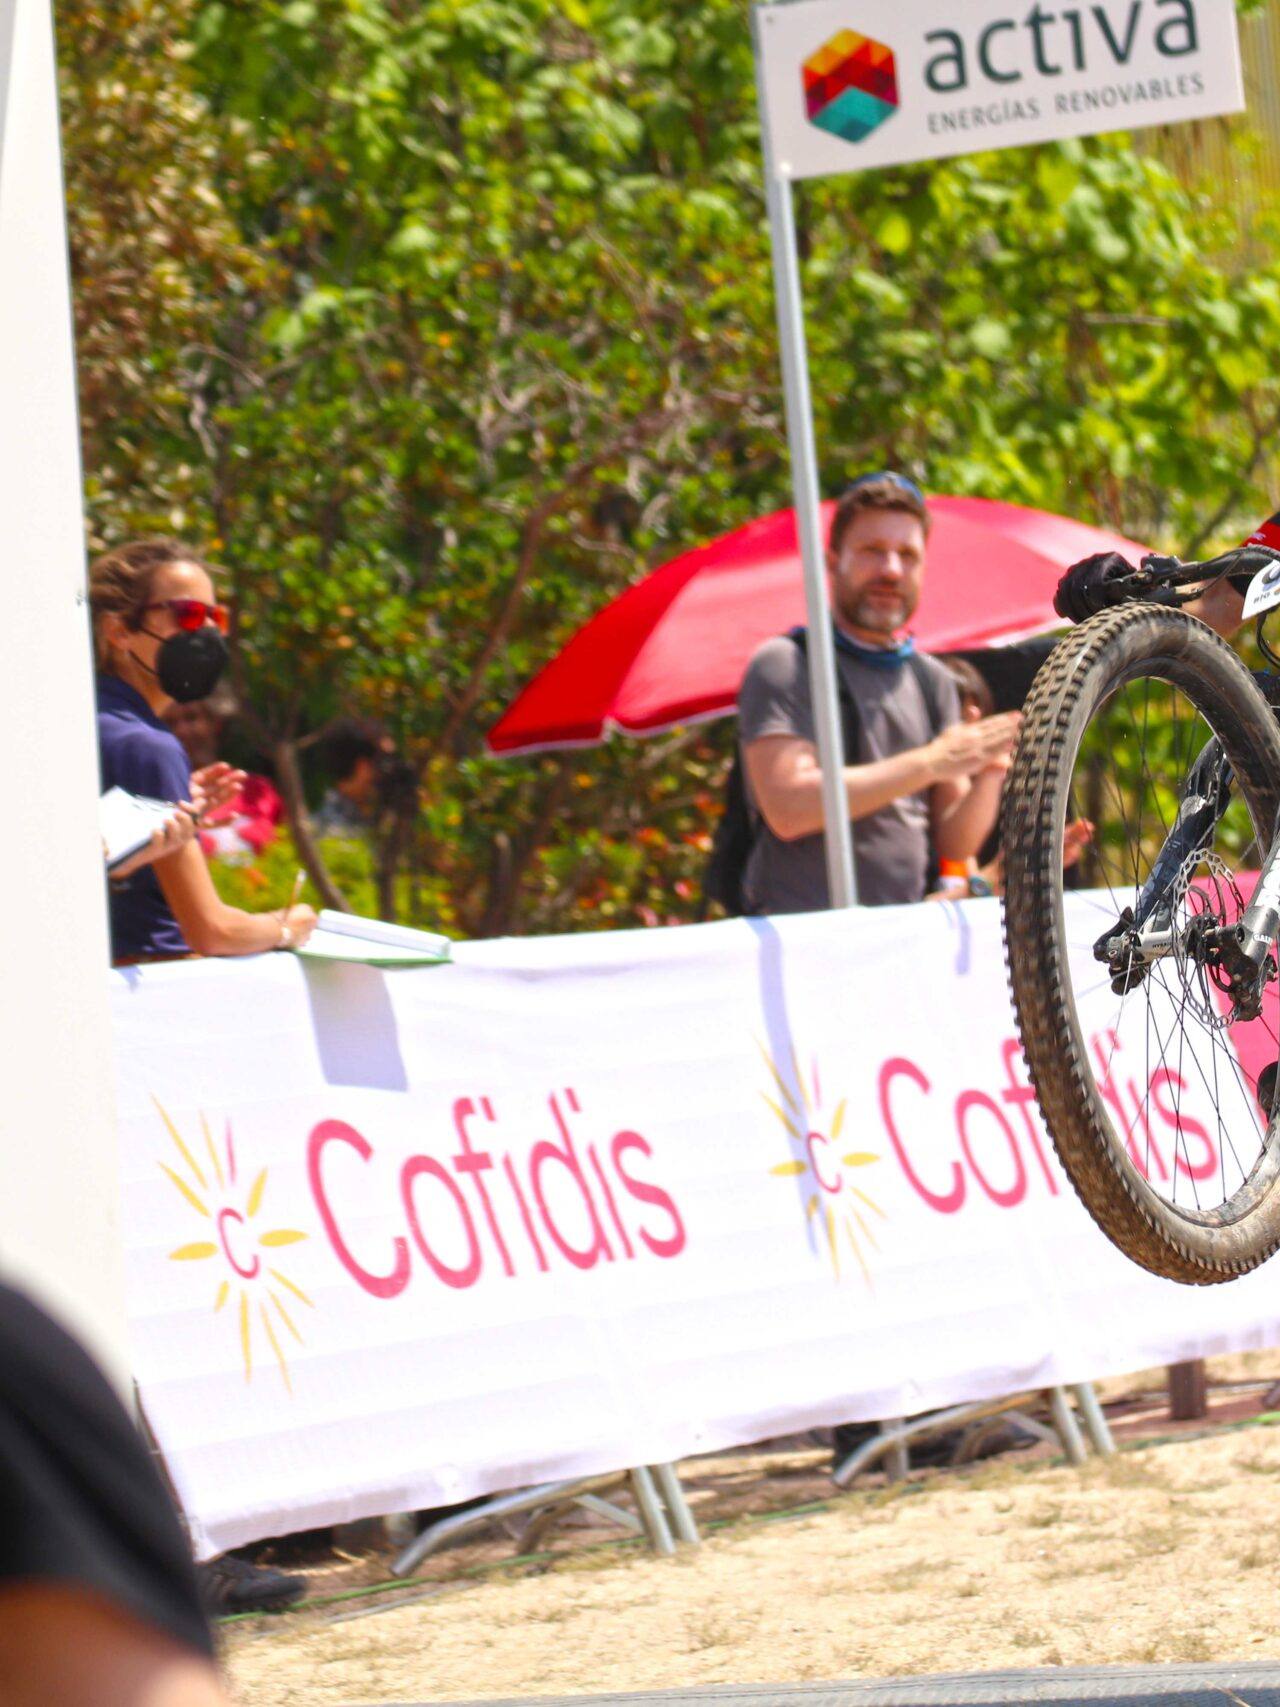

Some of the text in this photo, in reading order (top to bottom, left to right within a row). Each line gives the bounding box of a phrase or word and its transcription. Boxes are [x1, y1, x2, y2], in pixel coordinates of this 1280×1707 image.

[923, 0, 1200, 93] activa
[928, 75, 1205, 134] ENERGÍAS RENOVABLES
[877, 1028, 1218, 1214] Cofdis
[306, 1088, 687, 1299] Cofidis
